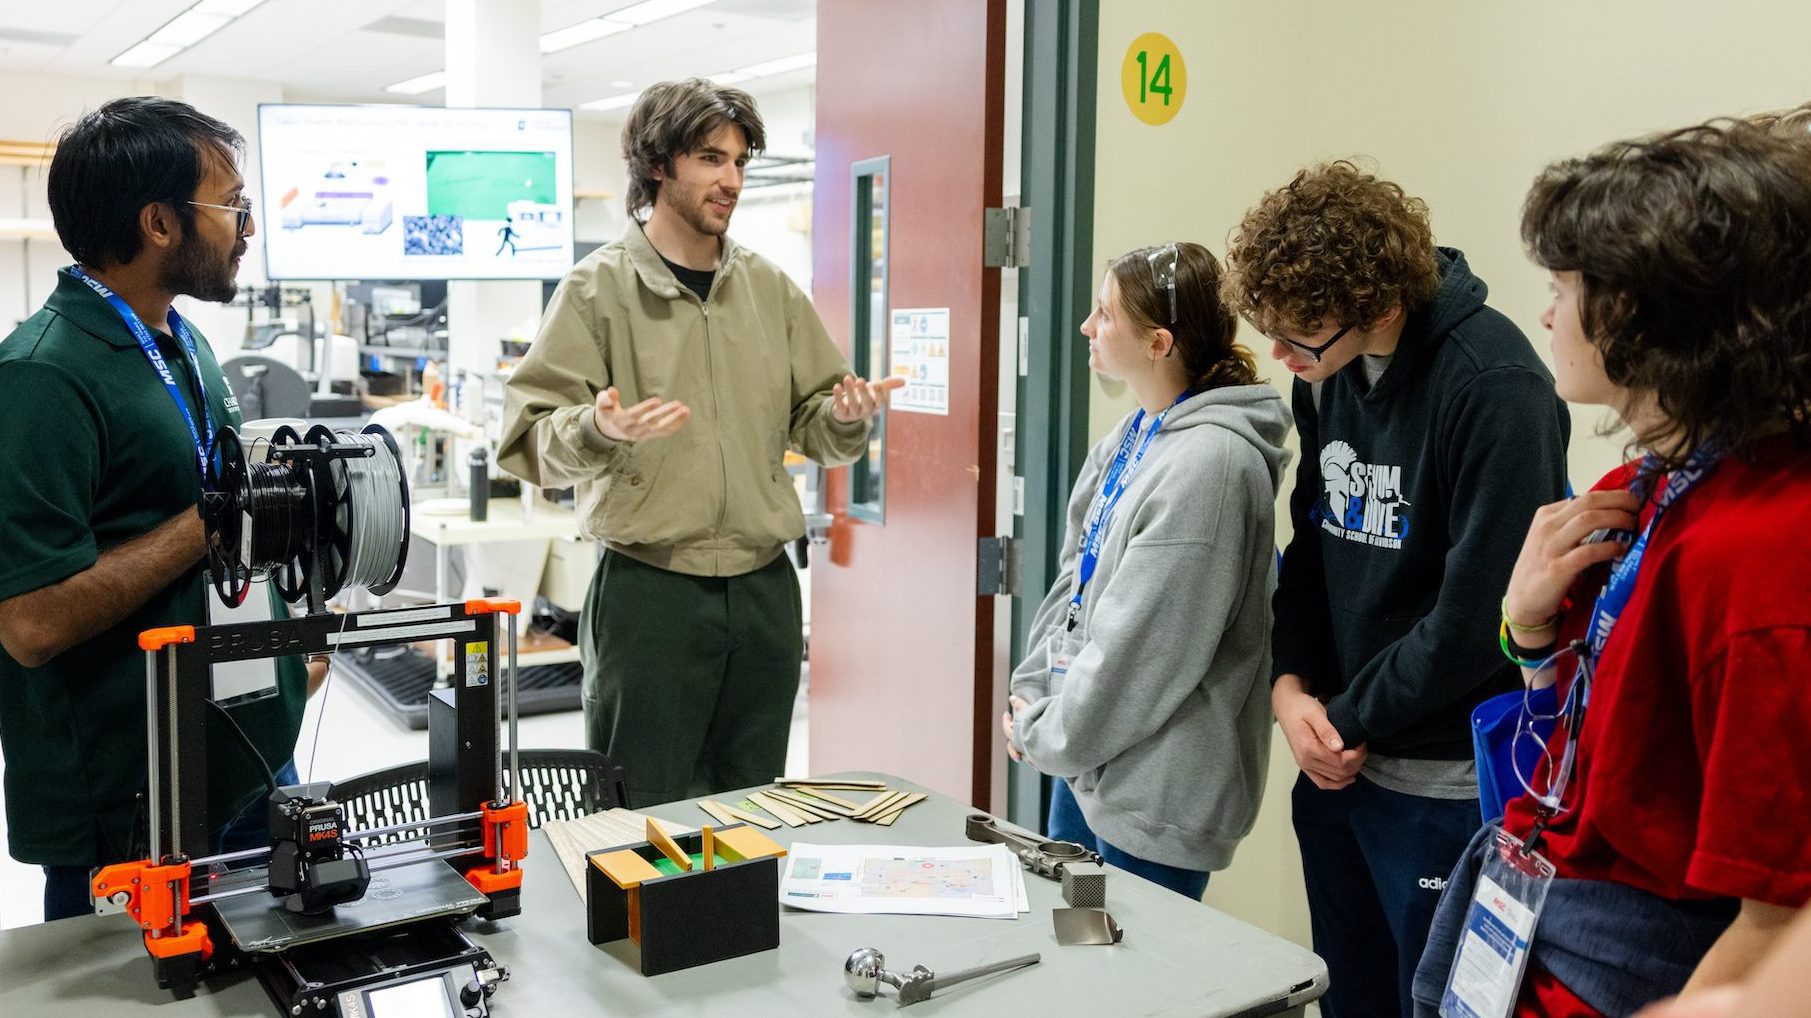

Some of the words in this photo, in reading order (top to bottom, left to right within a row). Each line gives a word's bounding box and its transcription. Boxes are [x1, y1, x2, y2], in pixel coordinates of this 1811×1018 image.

[1136, 51, 1173, 106] 14
[147, 349, 176, 387] MSC
[1120, 426, 1138, 459] MSC
[1374, 535, 1403, 550] AVIDSON
[309, 821, 338, 833] PRUSA
[309, 828, 338, 842] MK4S
